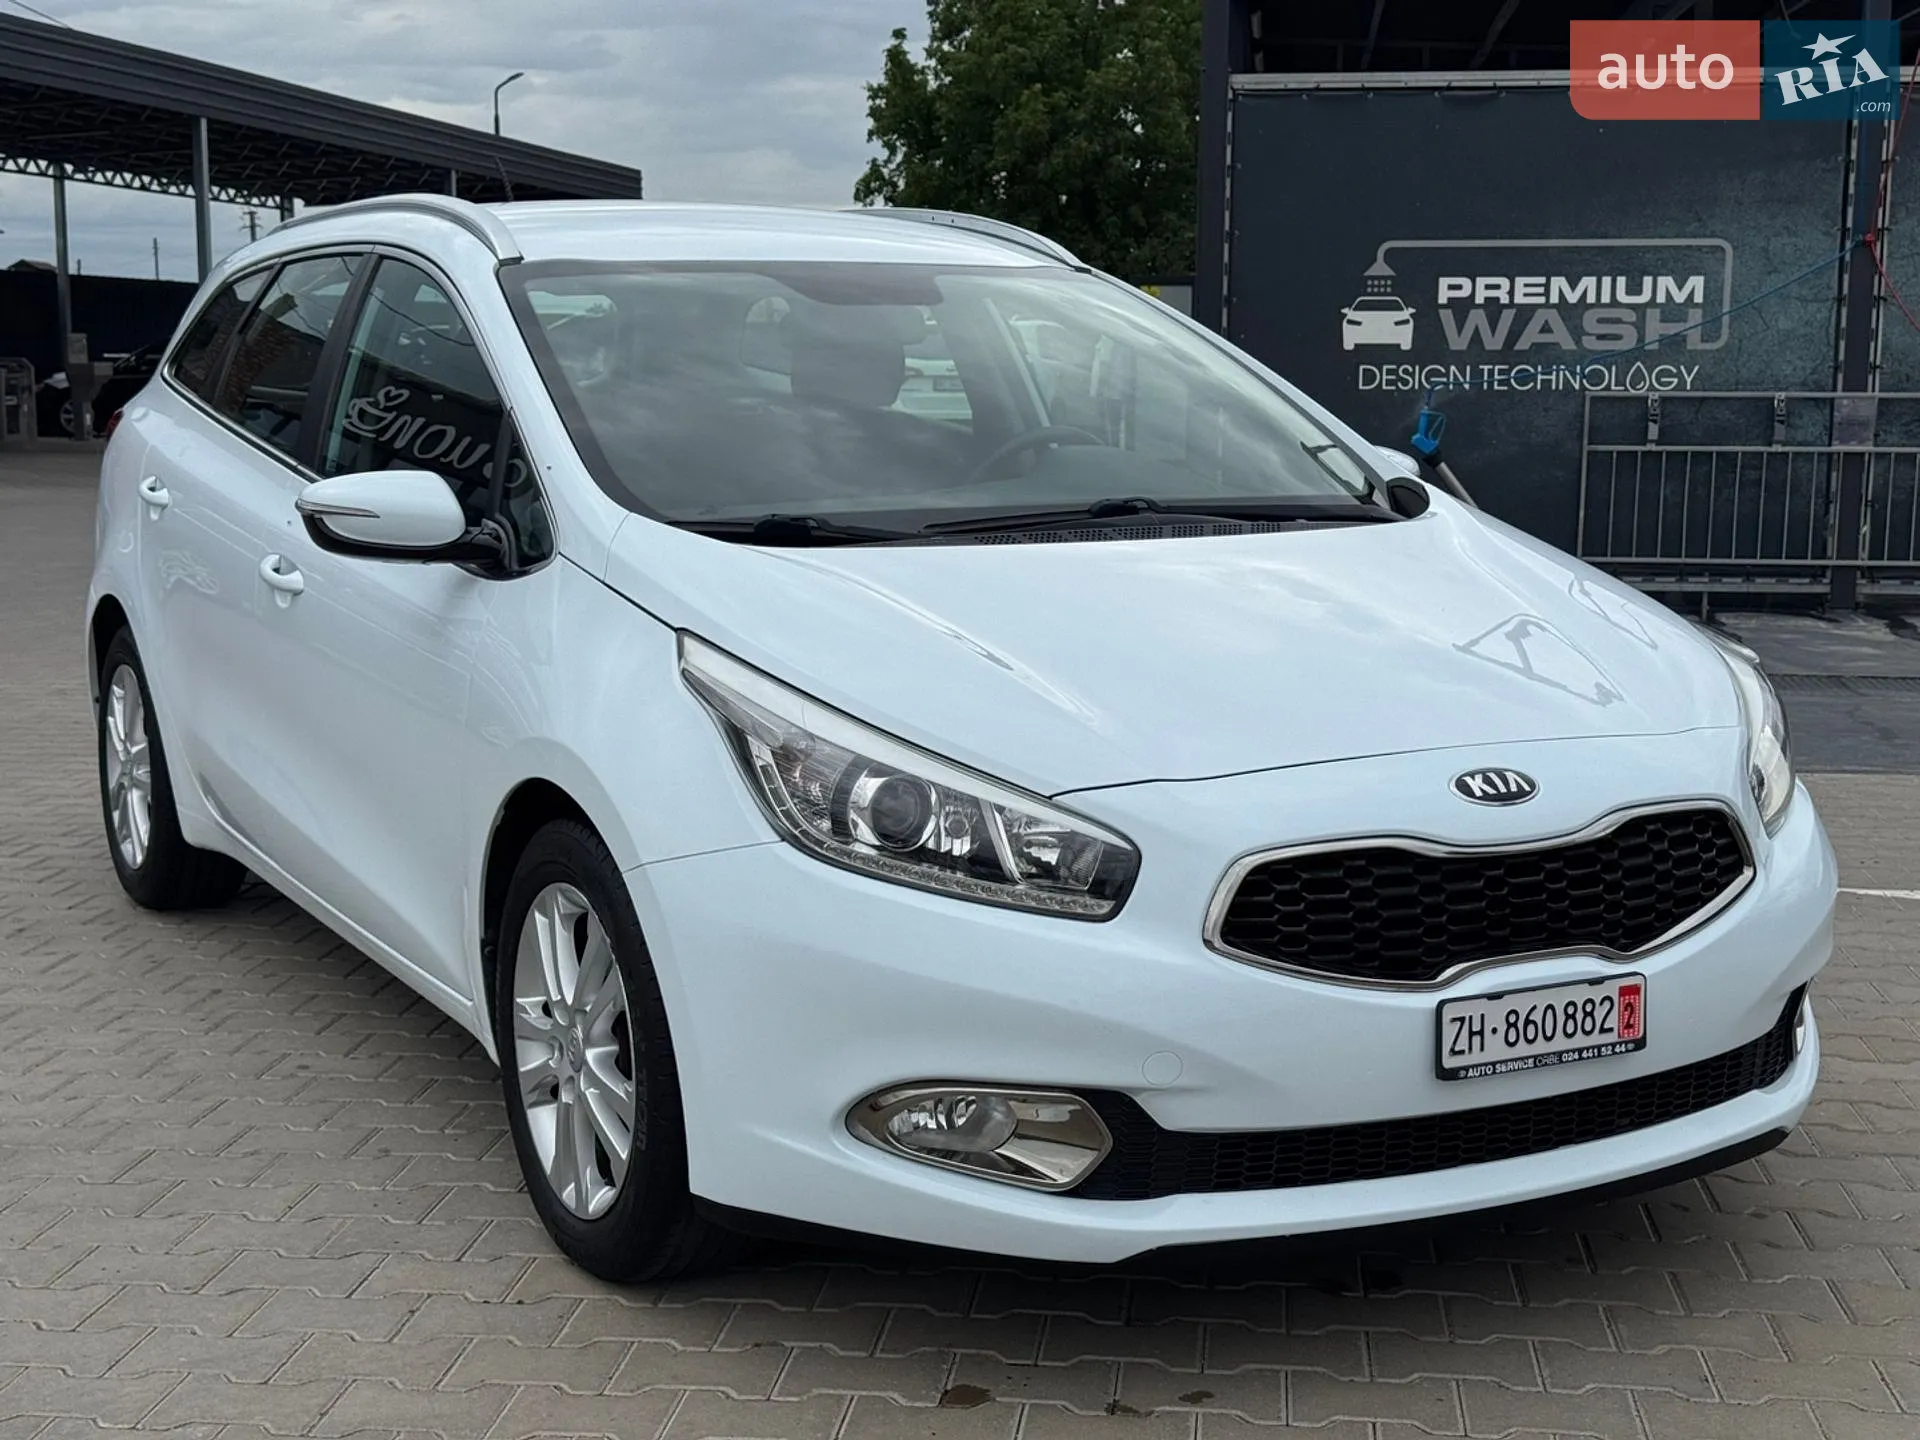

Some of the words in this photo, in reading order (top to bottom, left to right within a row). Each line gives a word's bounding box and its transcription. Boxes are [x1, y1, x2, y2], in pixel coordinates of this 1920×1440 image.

[1437, 276, 1706, 305] PREMIUM
[1437, 308, 1708, 351] WASH
[1358, 364, 1471, 391] DESIGN
[1461, 771, 1532, 797] KIA
[1467, 1065, 1493, 1078] AUTO
[1495, 1057, 1535, 1073] SERVICE
[1600, 1045, 1612, 1056] 52
